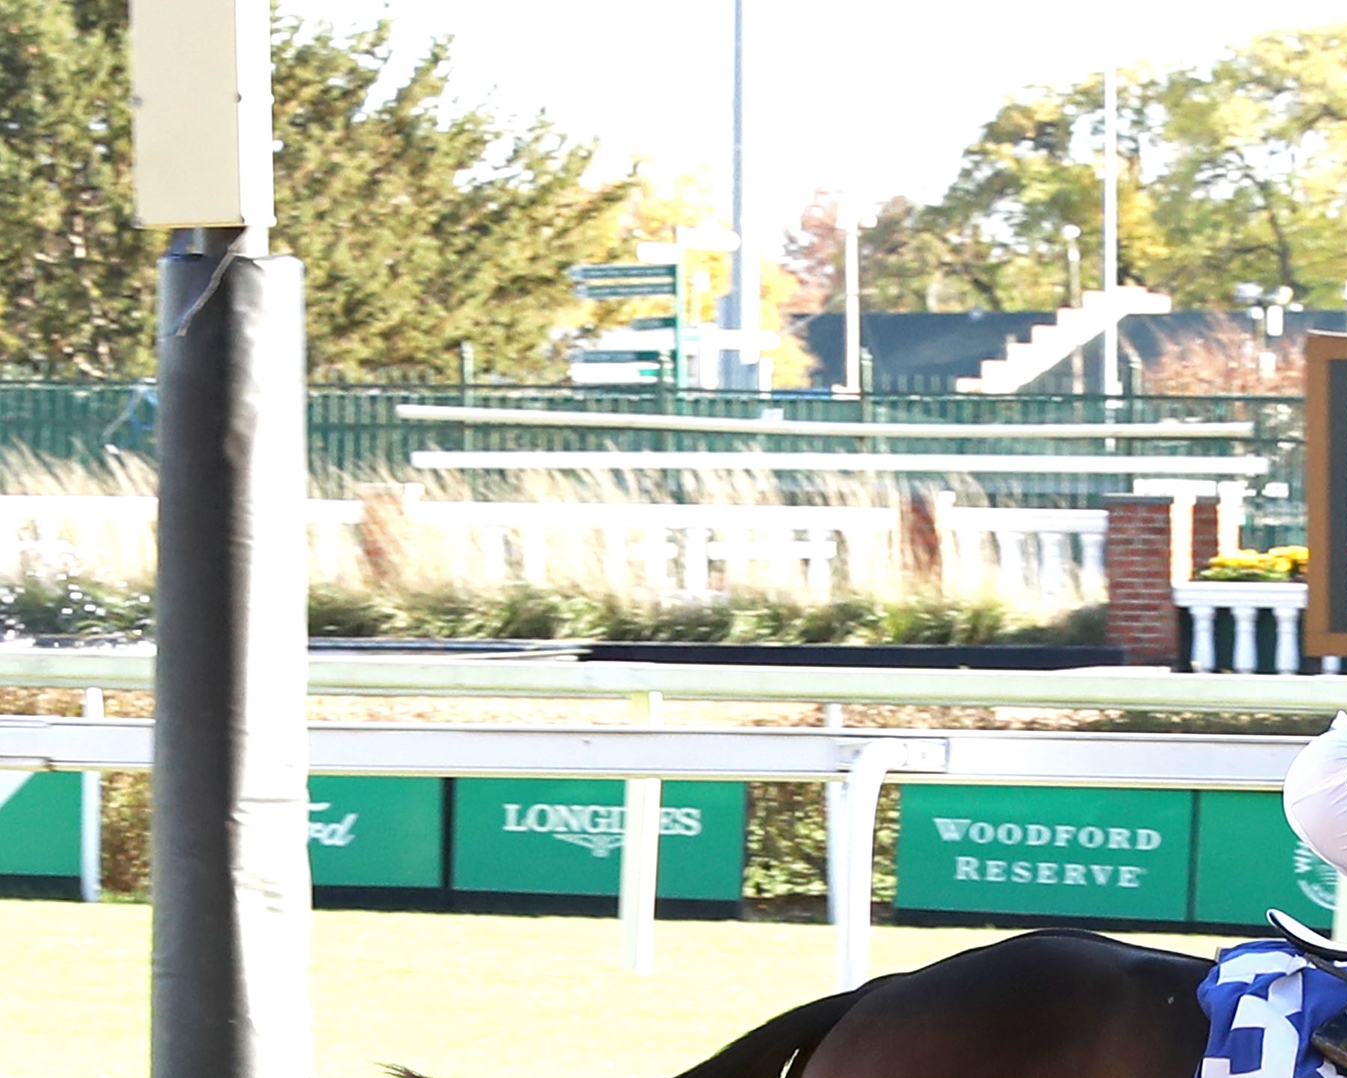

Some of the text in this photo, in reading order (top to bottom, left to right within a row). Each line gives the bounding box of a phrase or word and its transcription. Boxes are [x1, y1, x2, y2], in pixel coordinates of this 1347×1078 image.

[502, 803, 702, 837] LONGIES
[932, 817, 1162, 850] WOODFORD
[954, 856, 1141, 888] RESERVE
